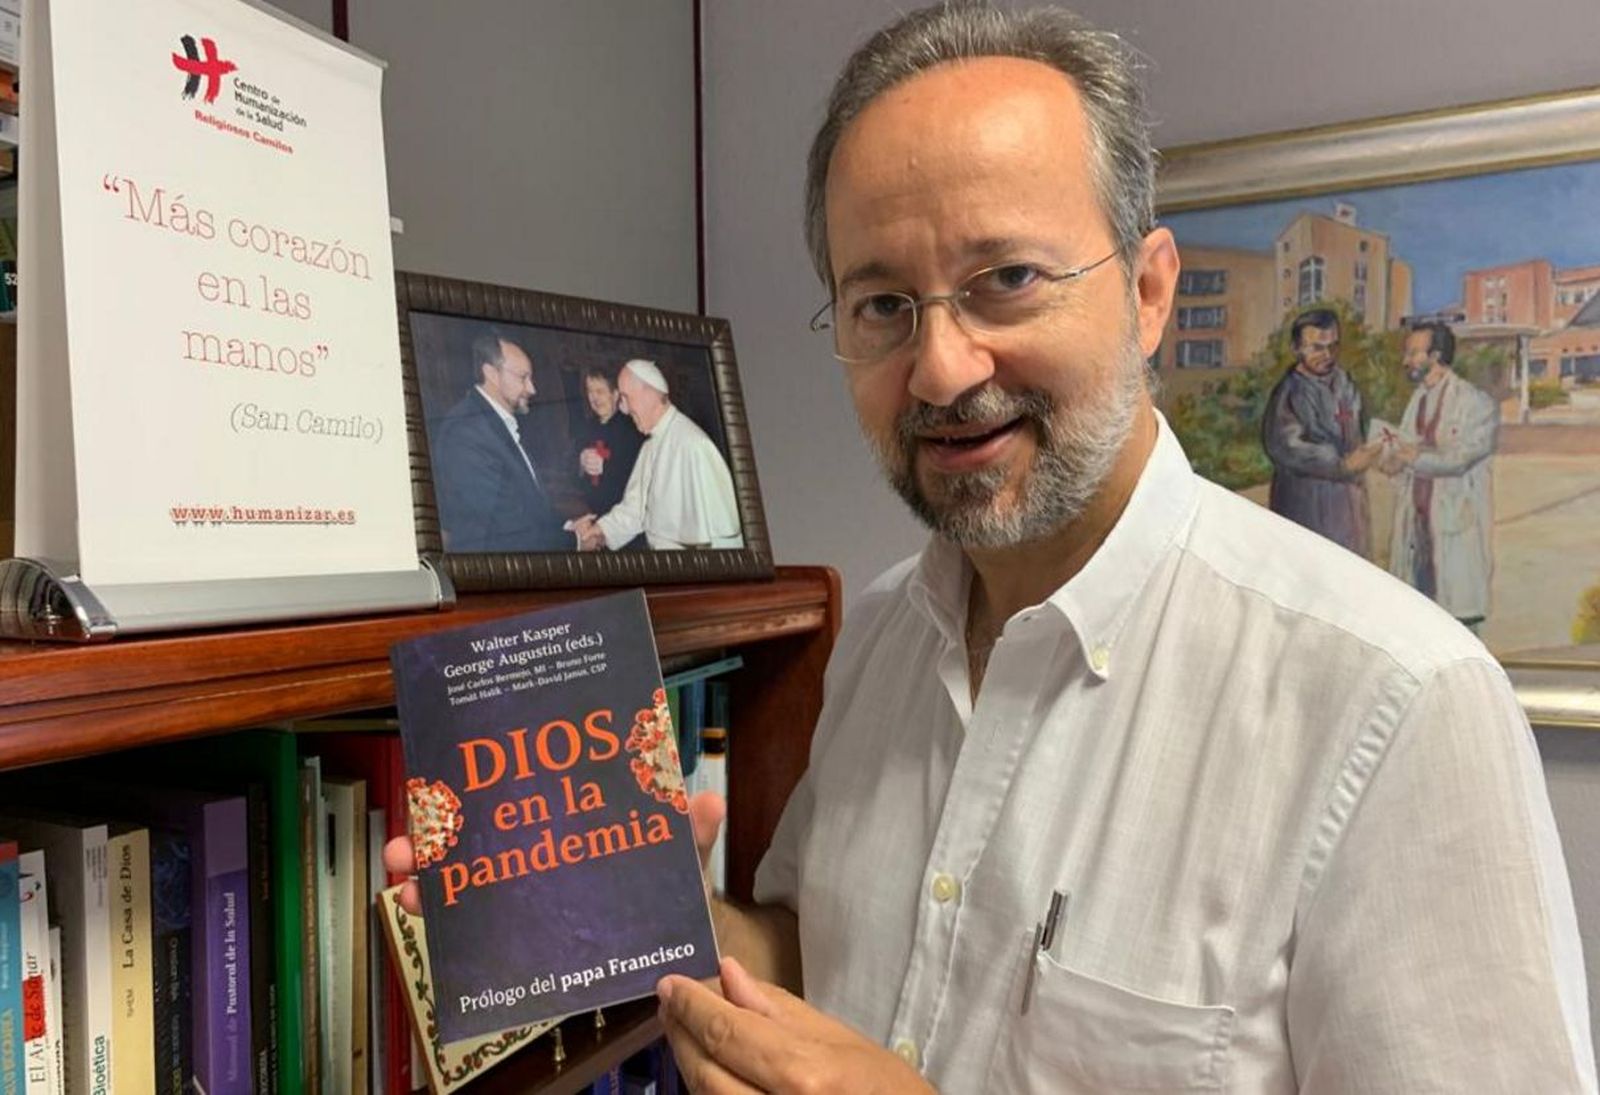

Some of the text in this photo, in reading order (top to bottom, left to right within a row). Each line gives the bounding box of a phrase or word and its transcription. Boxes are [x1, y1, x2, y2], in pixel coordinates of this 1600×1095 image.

[233, 77, 281, 104] Centro de
[234, 91, 307, 127] Humanización
[194, 109, 293, 154] Religiosos Camilos
[236, 108, 284, 132] de la Salud
[103, 174, 373, 281] “Más corazón
[198, 270, 312, 320] en las
[182, 329, 328, 378] manos”
[230, 402, 384, 444] (San Camilo)
[170, 503, 356, 527] www.humanizar.es
[444, 657, 495, 679] George
[565, 632, 604, 654] (eds.)
[471, 622, 572, 654] Walter Kasper
[447, 683, 466, 696] José
[467, 677, 494, 690] Carlos
[556, 658, 582, 670] Bruno
[584, 652, 606, 664] Forte
[590, 662, 608, 674] CSP
[457, 709, 620, 793] DIOS
[493, 776, 607, 831] en la
[441, 809, 673, 907] pandemia
[120, 844, 134, 969] La Casa de Dios
[224, 892, 236, 928] Salud
[225, 930, 236, 943] la
[225, 944, 237, 961] de
[226, 963, 238, 1015] Pastoral
[459, 943, 695, 1014] Prólogo del papa Francisco
[31, 1065, 45, 1083] El
